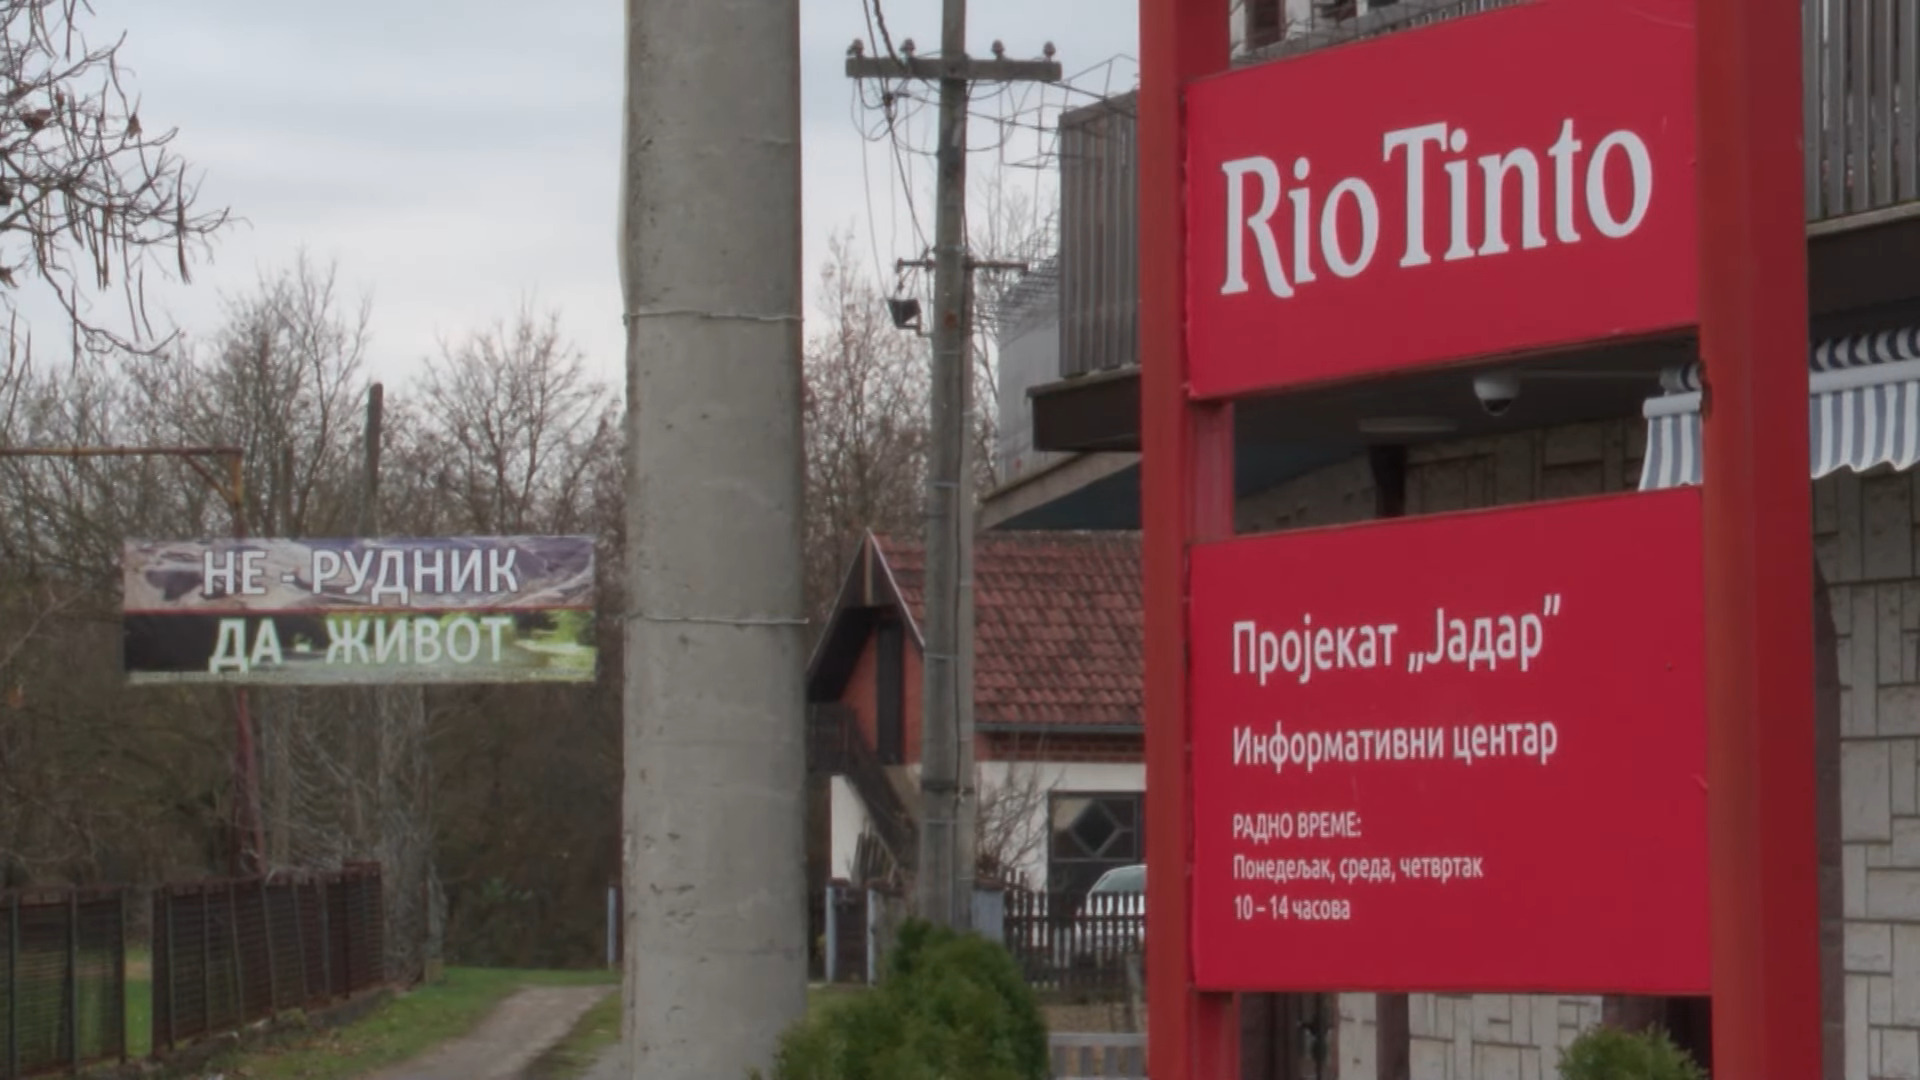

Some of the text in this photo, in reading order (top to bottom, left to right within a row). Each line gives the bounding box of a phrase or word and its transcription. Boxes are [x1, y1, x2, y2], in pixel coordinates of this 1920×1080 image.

[1221, 118, 1653, 299] Rio Tinto
[203, 550, 268, 594] НЕ
[312, 549, 520, 604] РУДНИК
[208, 618, 283, 674] ДА
[325, 616, 511, 665] ЖИВОТ
[1233, 613, 1398, 686] Пројекат
[1233, 721, 1558, 774] Информативни центар
[1233, 811, 1362, 844] РАДНО ВРЕМЕ:
[1233, 855, 1483, 884] Понедељак, среда, четвртак
[1235, 894, 1253, 920] 10
[1270, 894, 1288, 920] 14
[1292, 898, 1351, 920] часова
